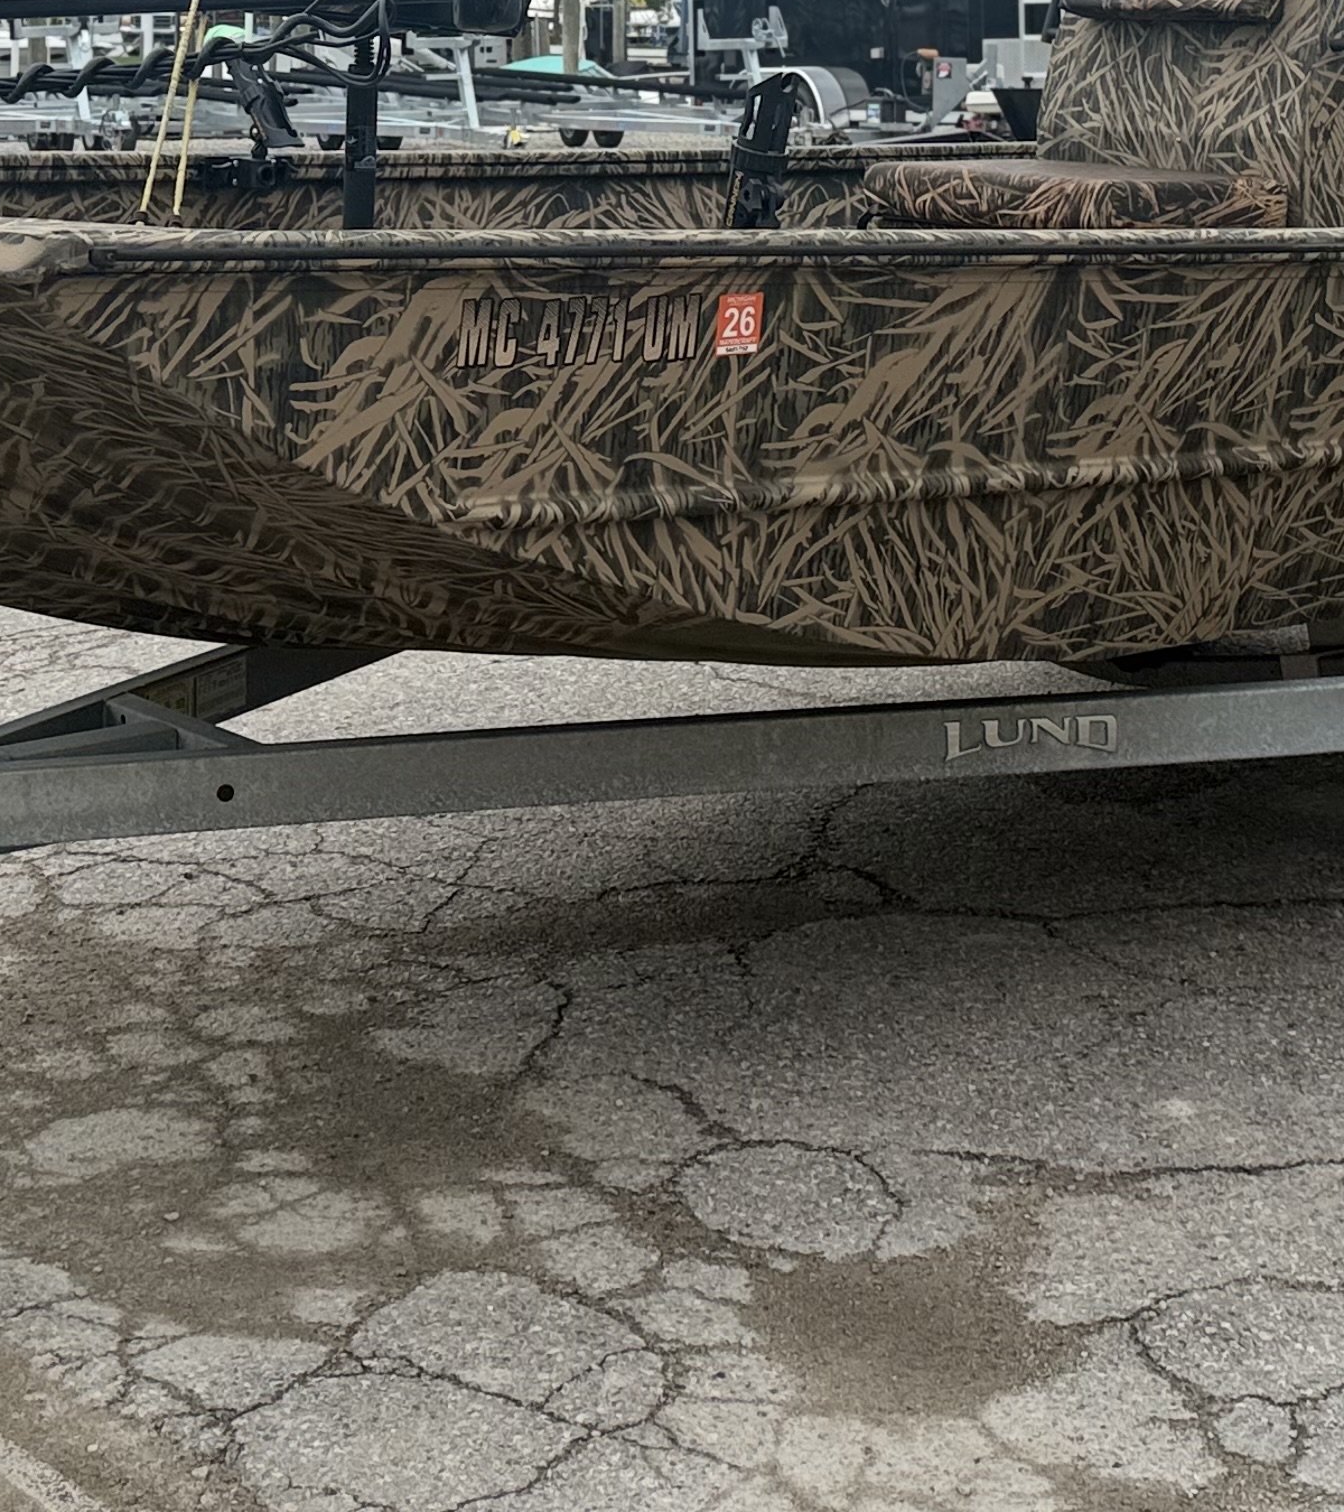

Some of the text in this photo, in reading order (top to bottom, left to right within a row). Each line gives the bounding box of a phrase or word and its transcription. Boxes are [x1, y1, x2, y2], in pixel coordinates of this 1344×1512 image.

[726, 170, 744, 226] CANNON
[456, 292, 702, 368] MC 4771 UM
[722, 306, 756, 338] 26
[943, 714, 1118, 762] LUND
